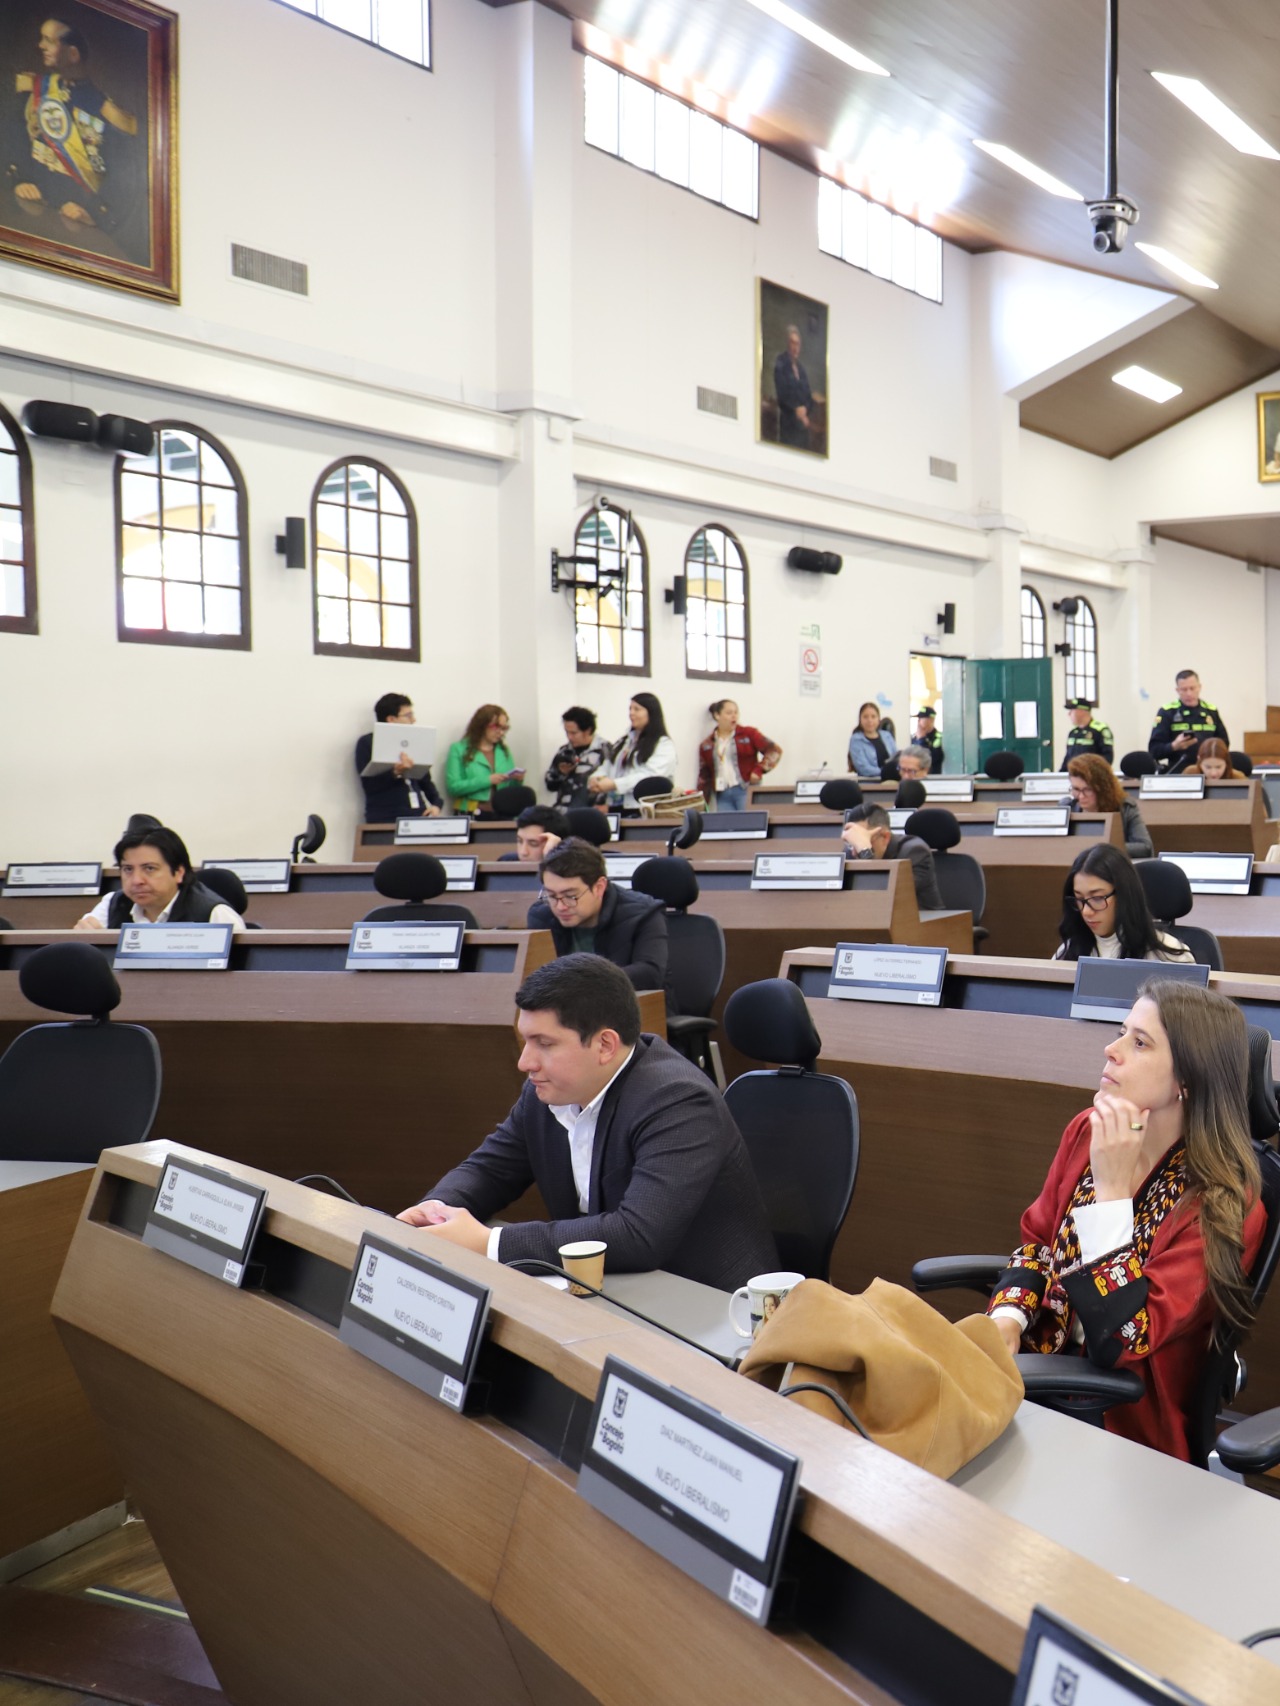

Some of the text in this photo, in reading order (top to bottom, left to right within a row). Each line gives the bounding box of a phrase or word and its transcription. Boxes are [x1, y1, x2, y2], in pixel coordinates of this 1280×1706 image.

[394, 1308, 443, 1342] NUEVO LIBERALISMO
[601, 1417, 625, 1440] Concejo
[602, 1431, 625, 1455] Bogotá
[702, 1450, 718, 1467] JUAN
[718, 1459, 743, 1482] MANUEL
[655, 1465, 730, 1523] NUEVO LIBERALISMO
